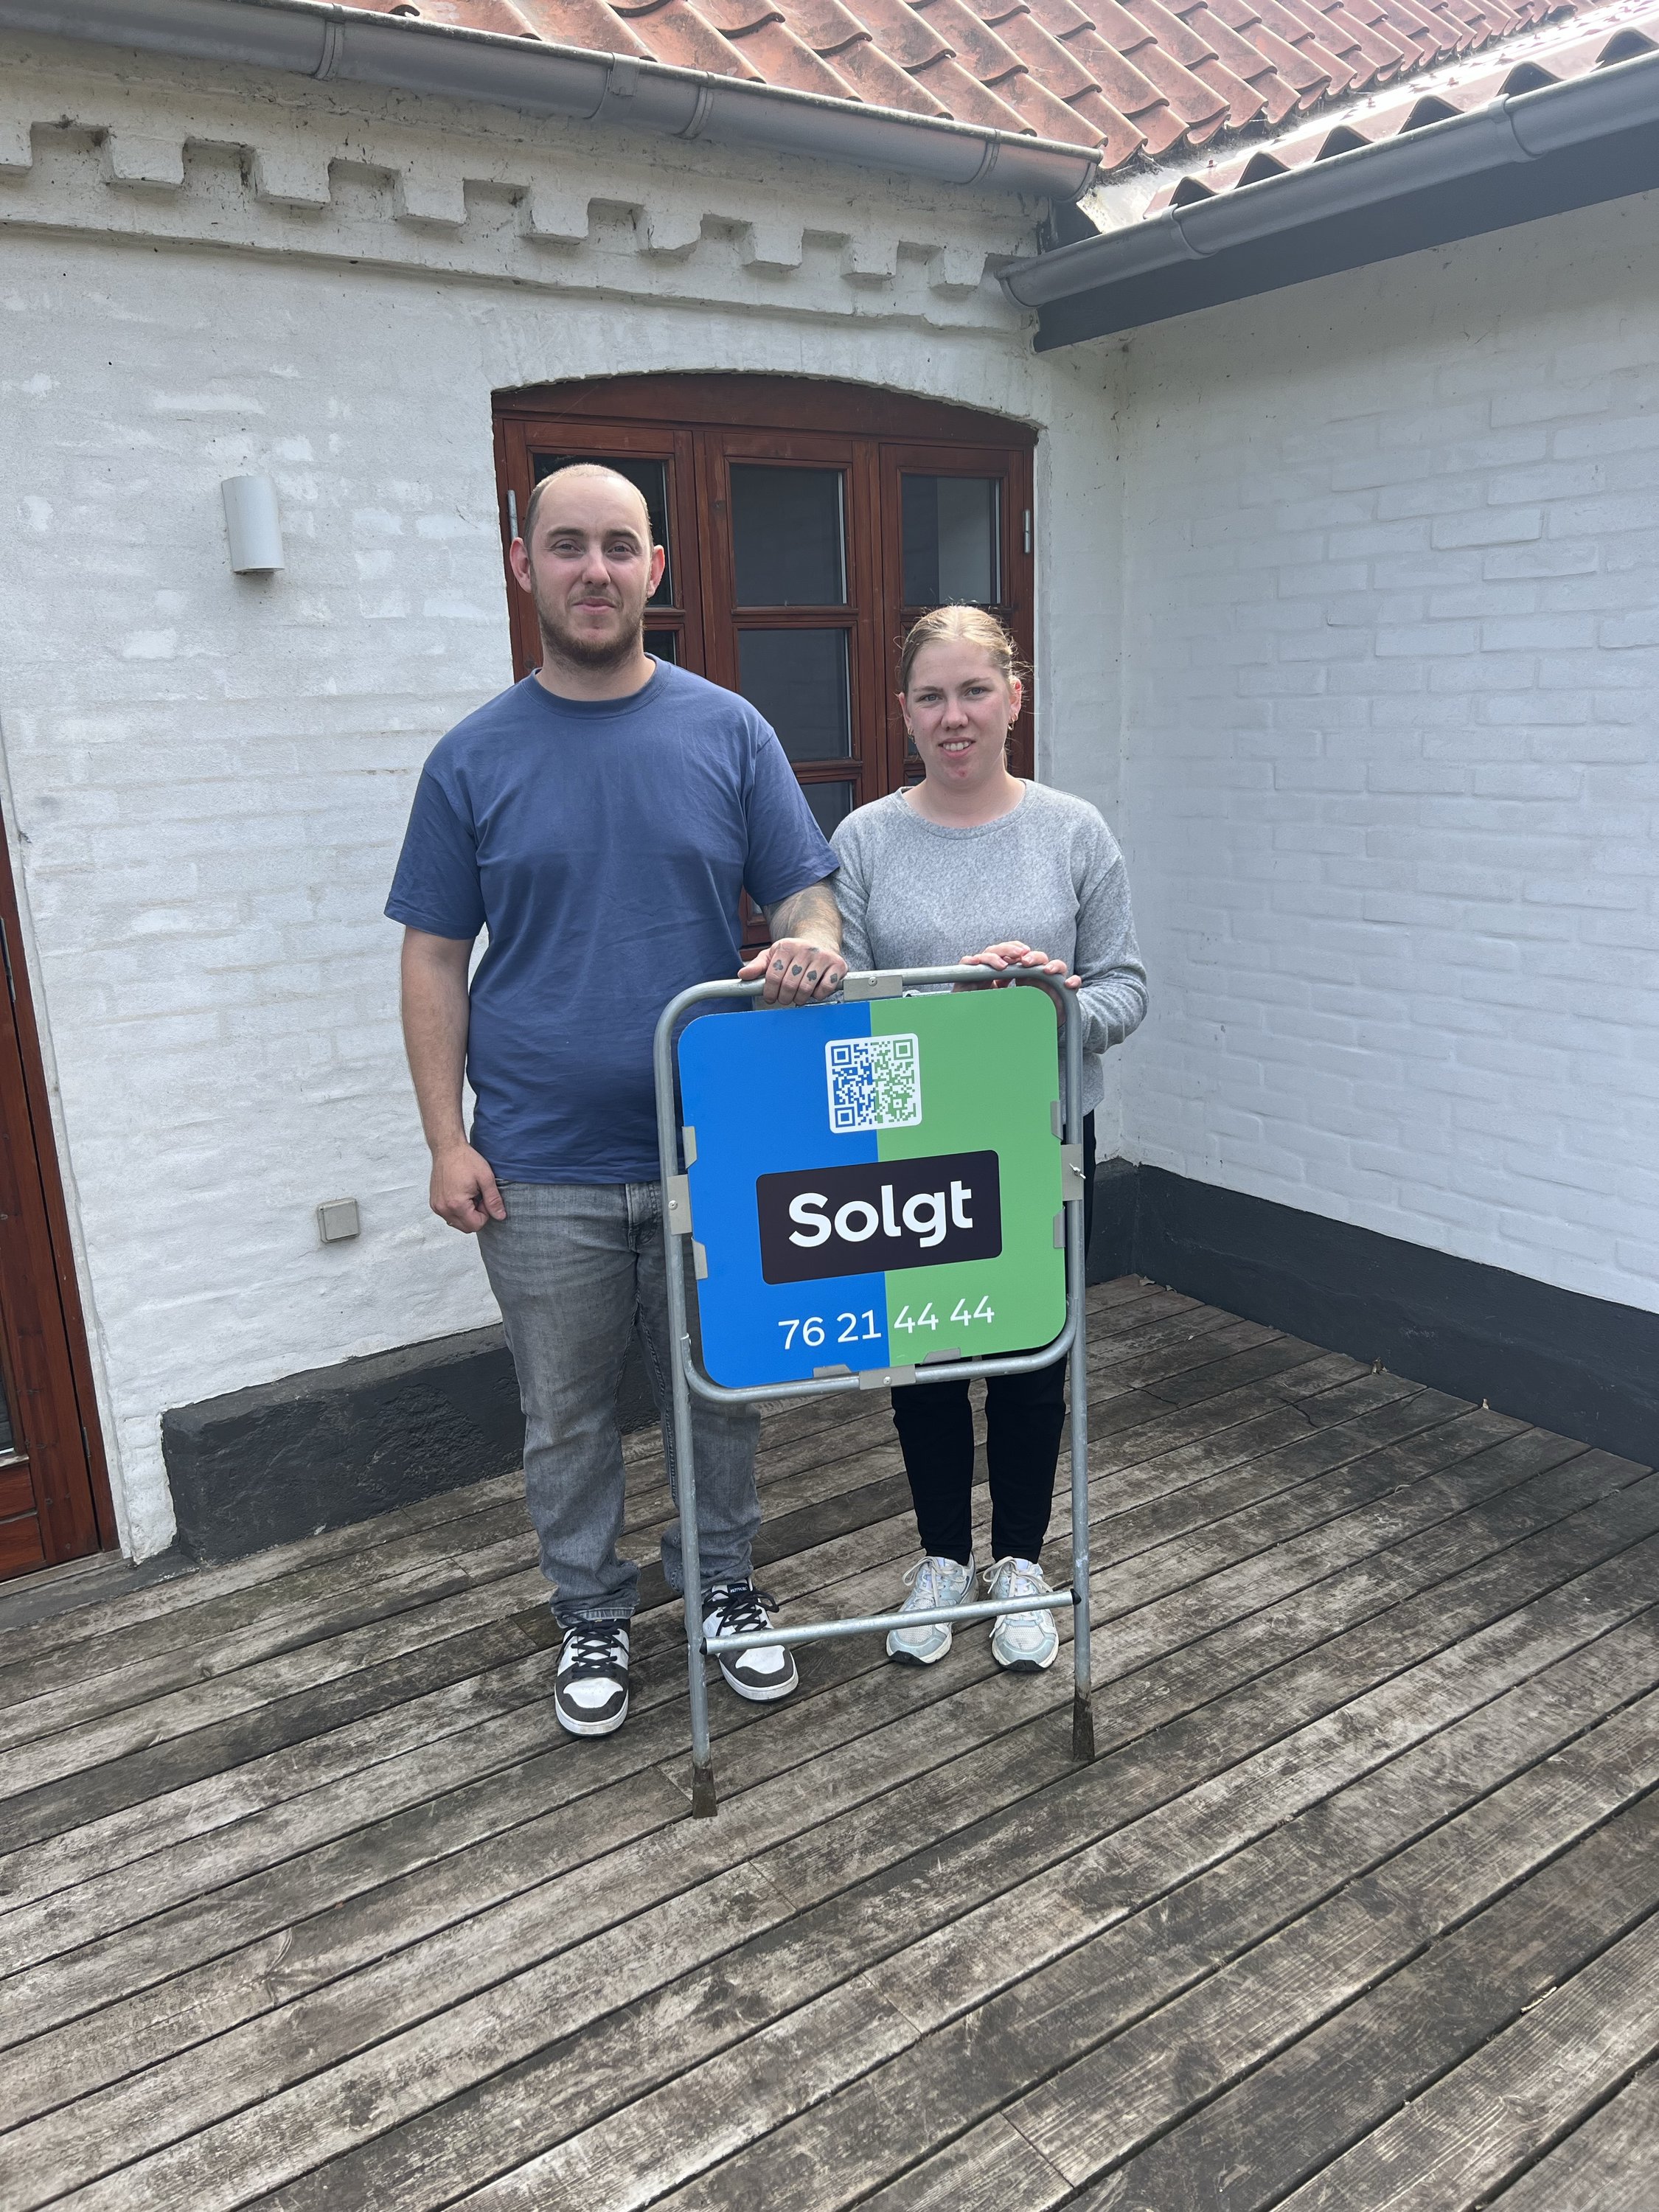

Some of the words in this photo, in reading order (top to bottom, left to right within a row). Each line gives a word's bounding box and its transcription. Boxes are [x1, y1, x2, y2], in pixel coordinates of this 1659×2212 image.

[787, 1180, 973, 1248] Solgt
[778, 1316, 826, 1350] 76
[836, 1310, 882, 1343] 21
[893, 1302, 939, 1334] 44
[950, 1295, 995, 1326] 44
